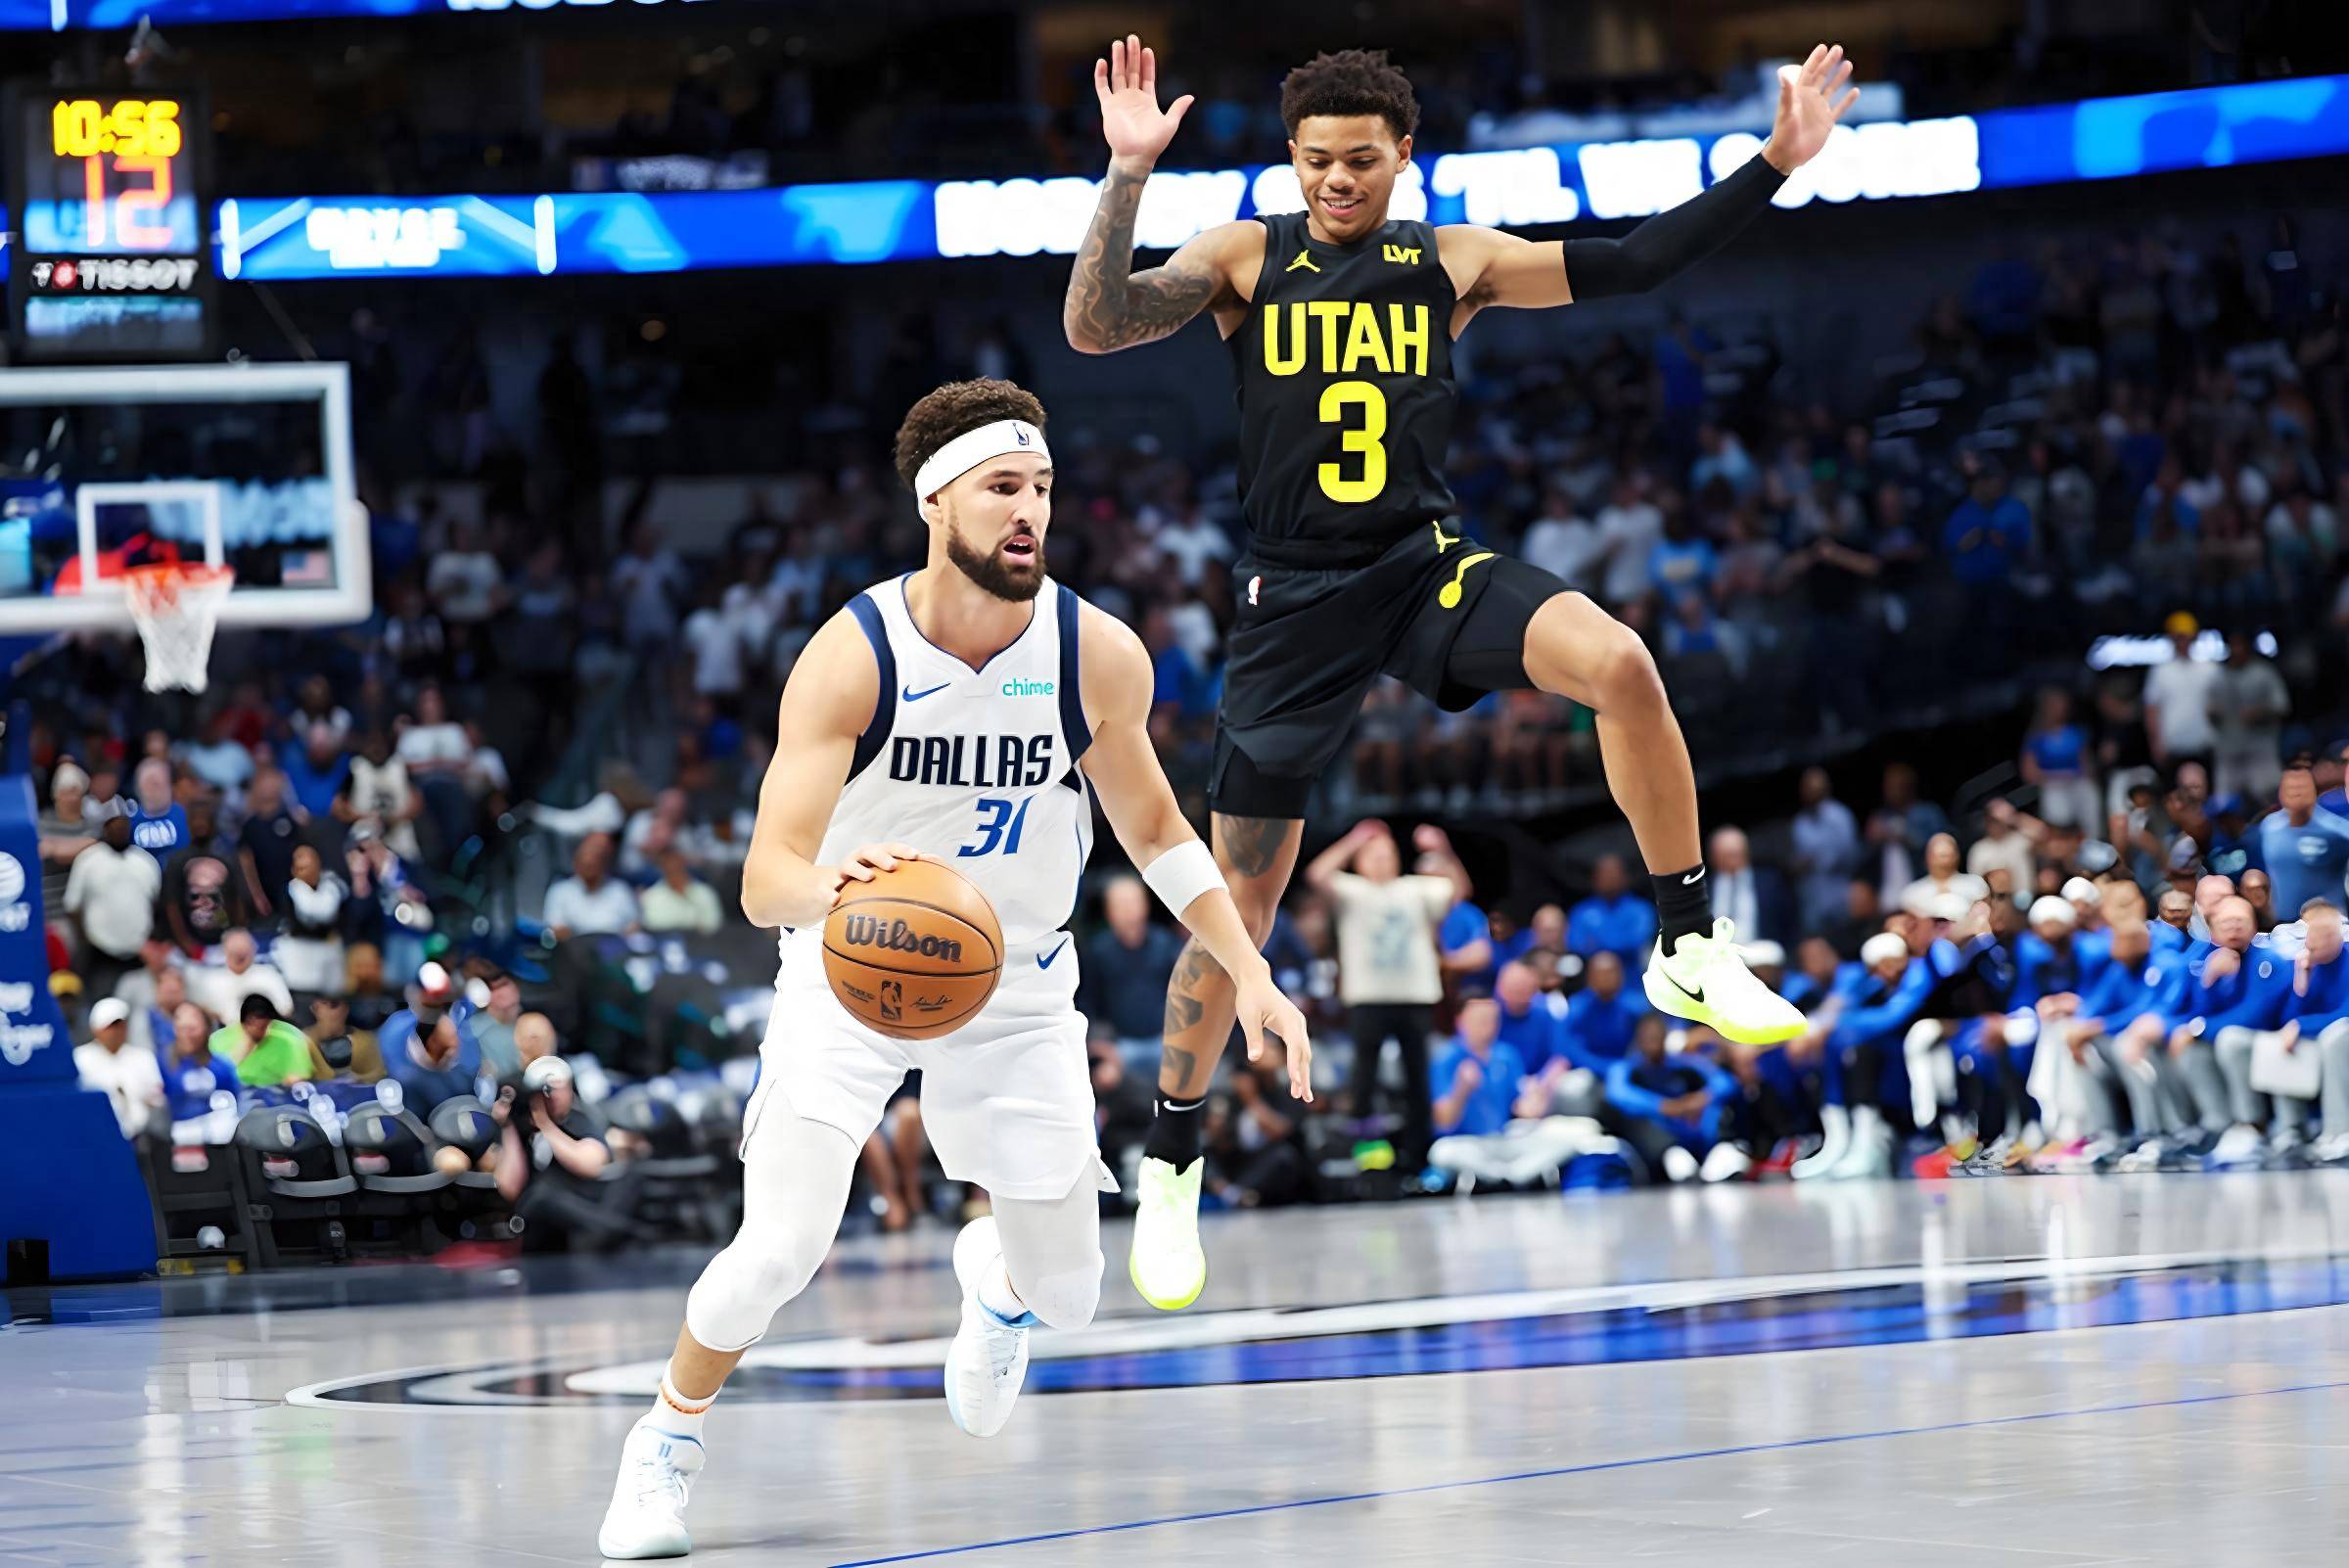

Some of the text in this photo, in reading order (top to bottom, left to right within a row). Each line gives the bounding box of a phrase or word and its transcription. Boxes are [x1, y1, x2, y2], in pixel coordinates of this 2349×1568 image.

[53, 100, 181, 158] 10:56
[85, 155, 174, 250] 12
[76, 258, 199, 291] TISSOT
[1382, 244, 1422, 265] LVT
[1264, 300, 1429, 377] UTAH
[1317, 380, 1388, 503] 3
[1001, 677, 1055, 697] chime
[889, 734, 1054, 788] DALLAS
[955, 792, 1039, 858] 31
[844, 914, 962, 963] Wilson
